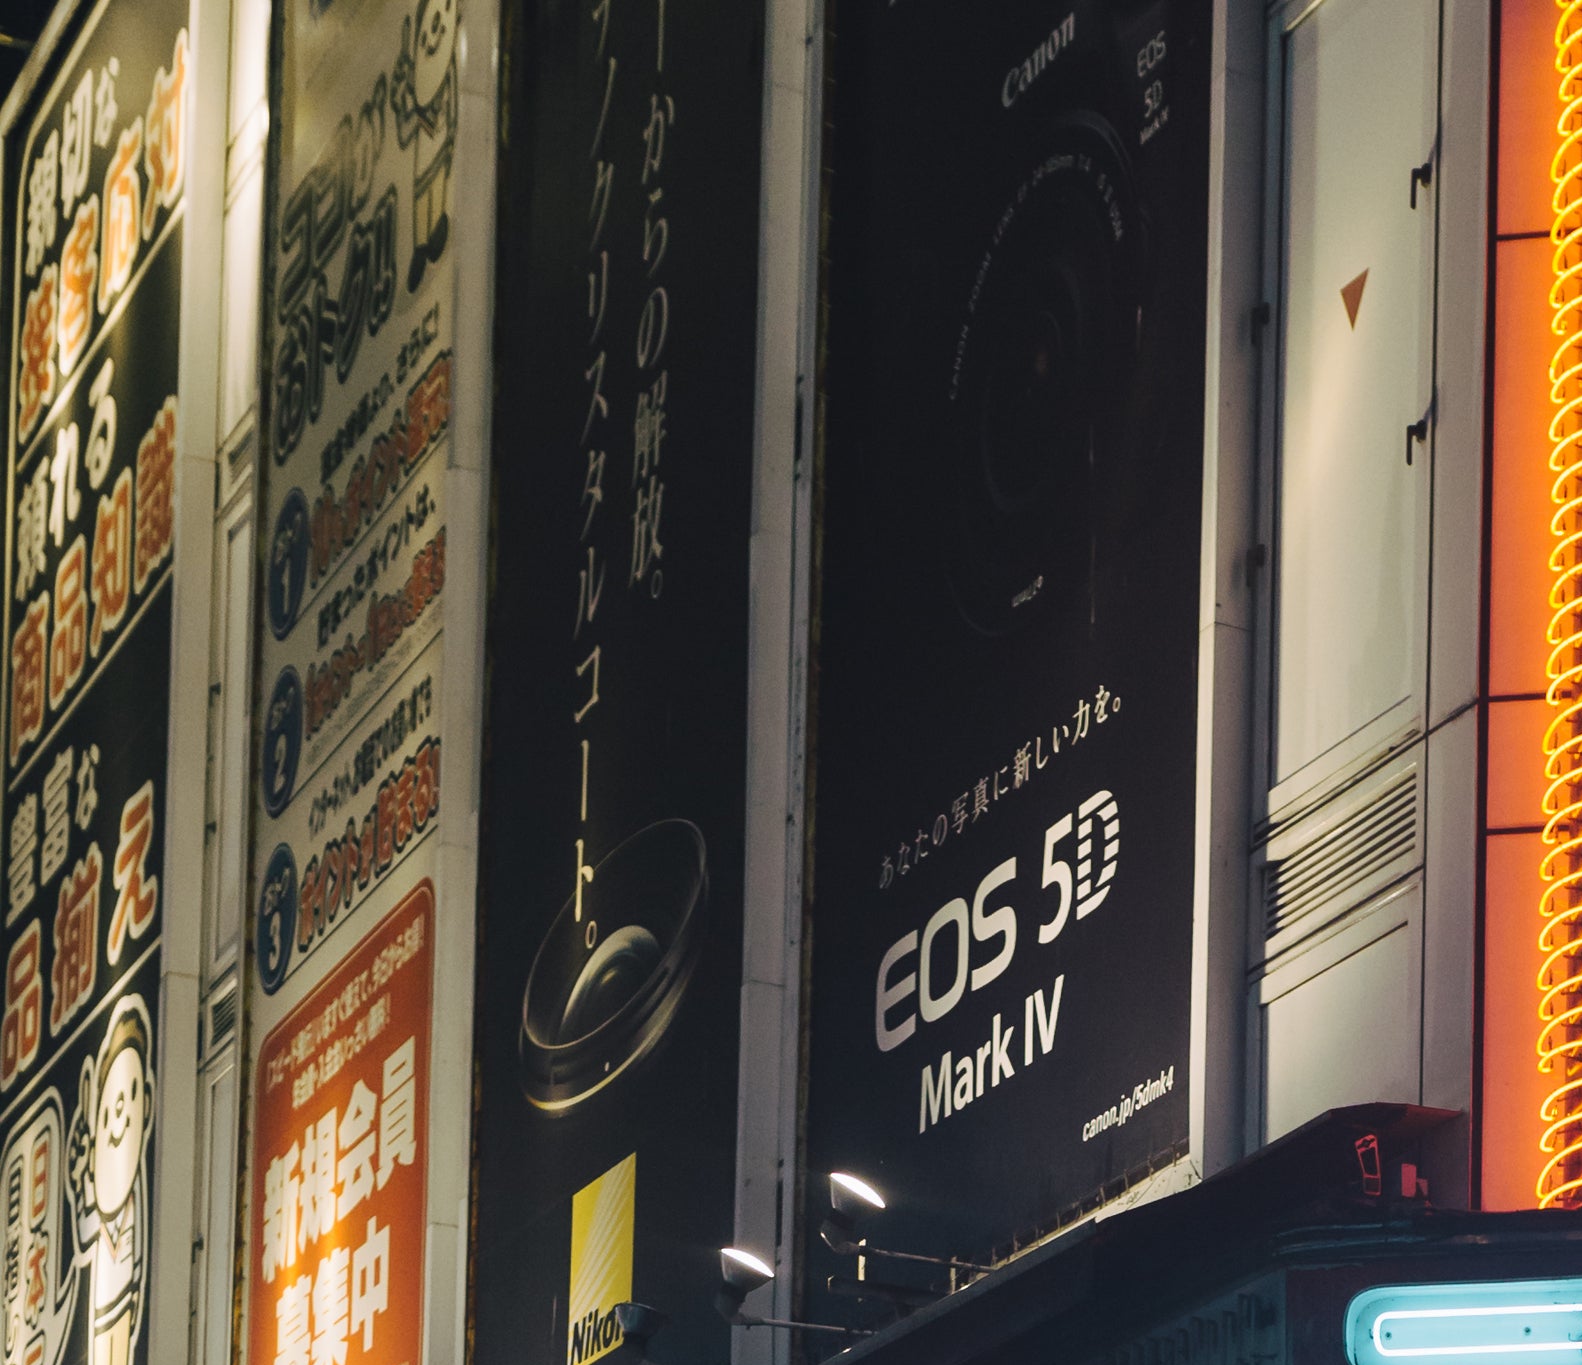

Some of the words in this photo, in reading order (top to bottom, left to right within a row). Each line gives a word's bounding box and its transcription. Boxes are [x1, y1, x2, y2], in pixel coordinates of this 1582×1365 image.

[1001, 13, 1074, 108] Canon
[1137, 31, 1166, 77] EOS
[1144, 80, 1163, 118] 5D
[16, 358, 117, 600] 頼れる
[878, 684, 1122, 891] あなたの写真に新しい力を。
[2, 779, 155, 1091] 品揃え
[265, 910, 282, 969] 3
[875, 856, 1017, 1053] EOS
[1039, 789, 1120, 945] 5D
[917, 1016, 1014, 1135] Mark
[1024, 975, 1065, 1068] IV
[1082, 1064, 1175, 1142] canon.jp/5dmk4
[261, 1035, 417, 1285] 新規会員
